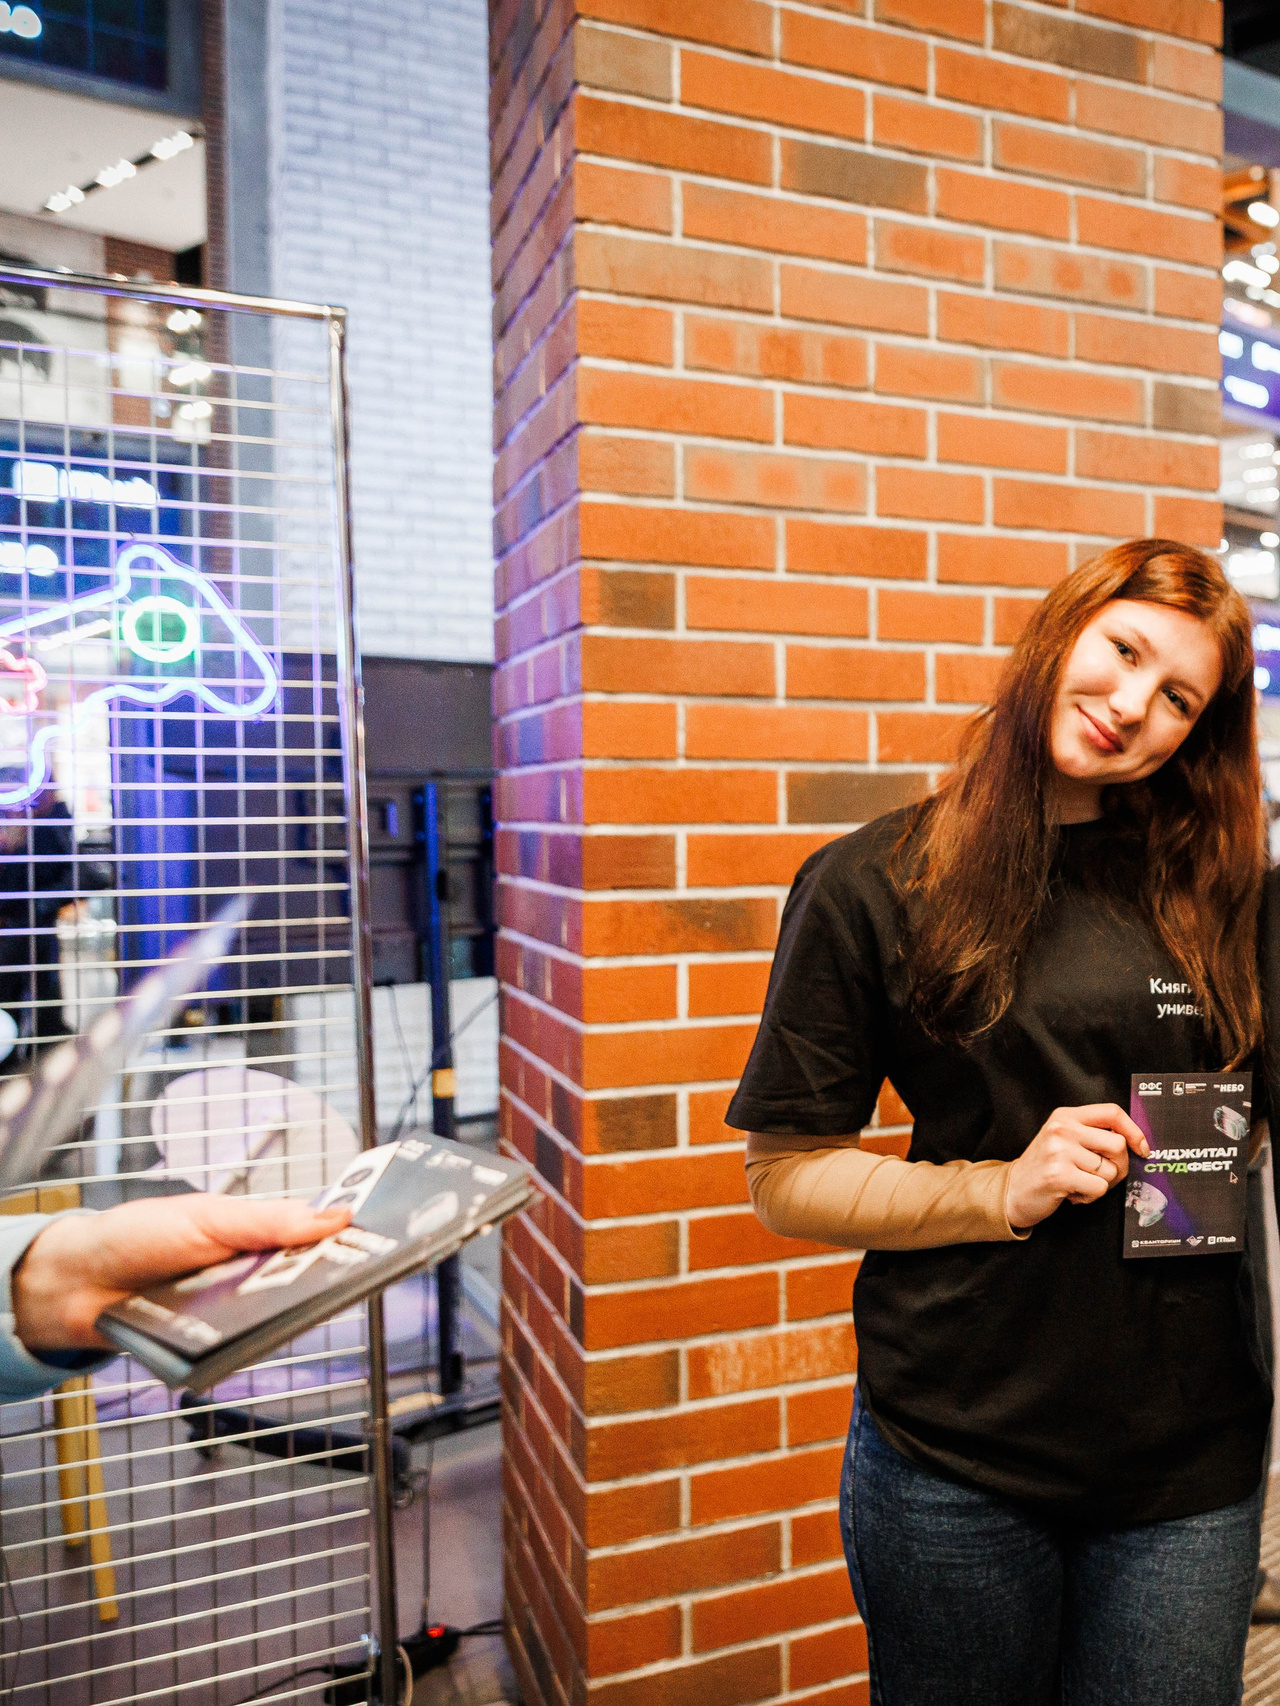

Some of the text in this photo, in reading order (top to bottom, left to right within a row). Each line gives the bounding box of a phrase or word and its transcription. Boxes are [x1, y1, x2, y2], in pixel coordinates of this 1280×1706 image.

[1149, 977, 1193, 995] Княг
[1138, 1082, 1163, 1091] ФФС
[1219, 1083, 1245, 1093] НЕБО
[1144, 1160, 1233, 1173] СТУДФЕСТ
